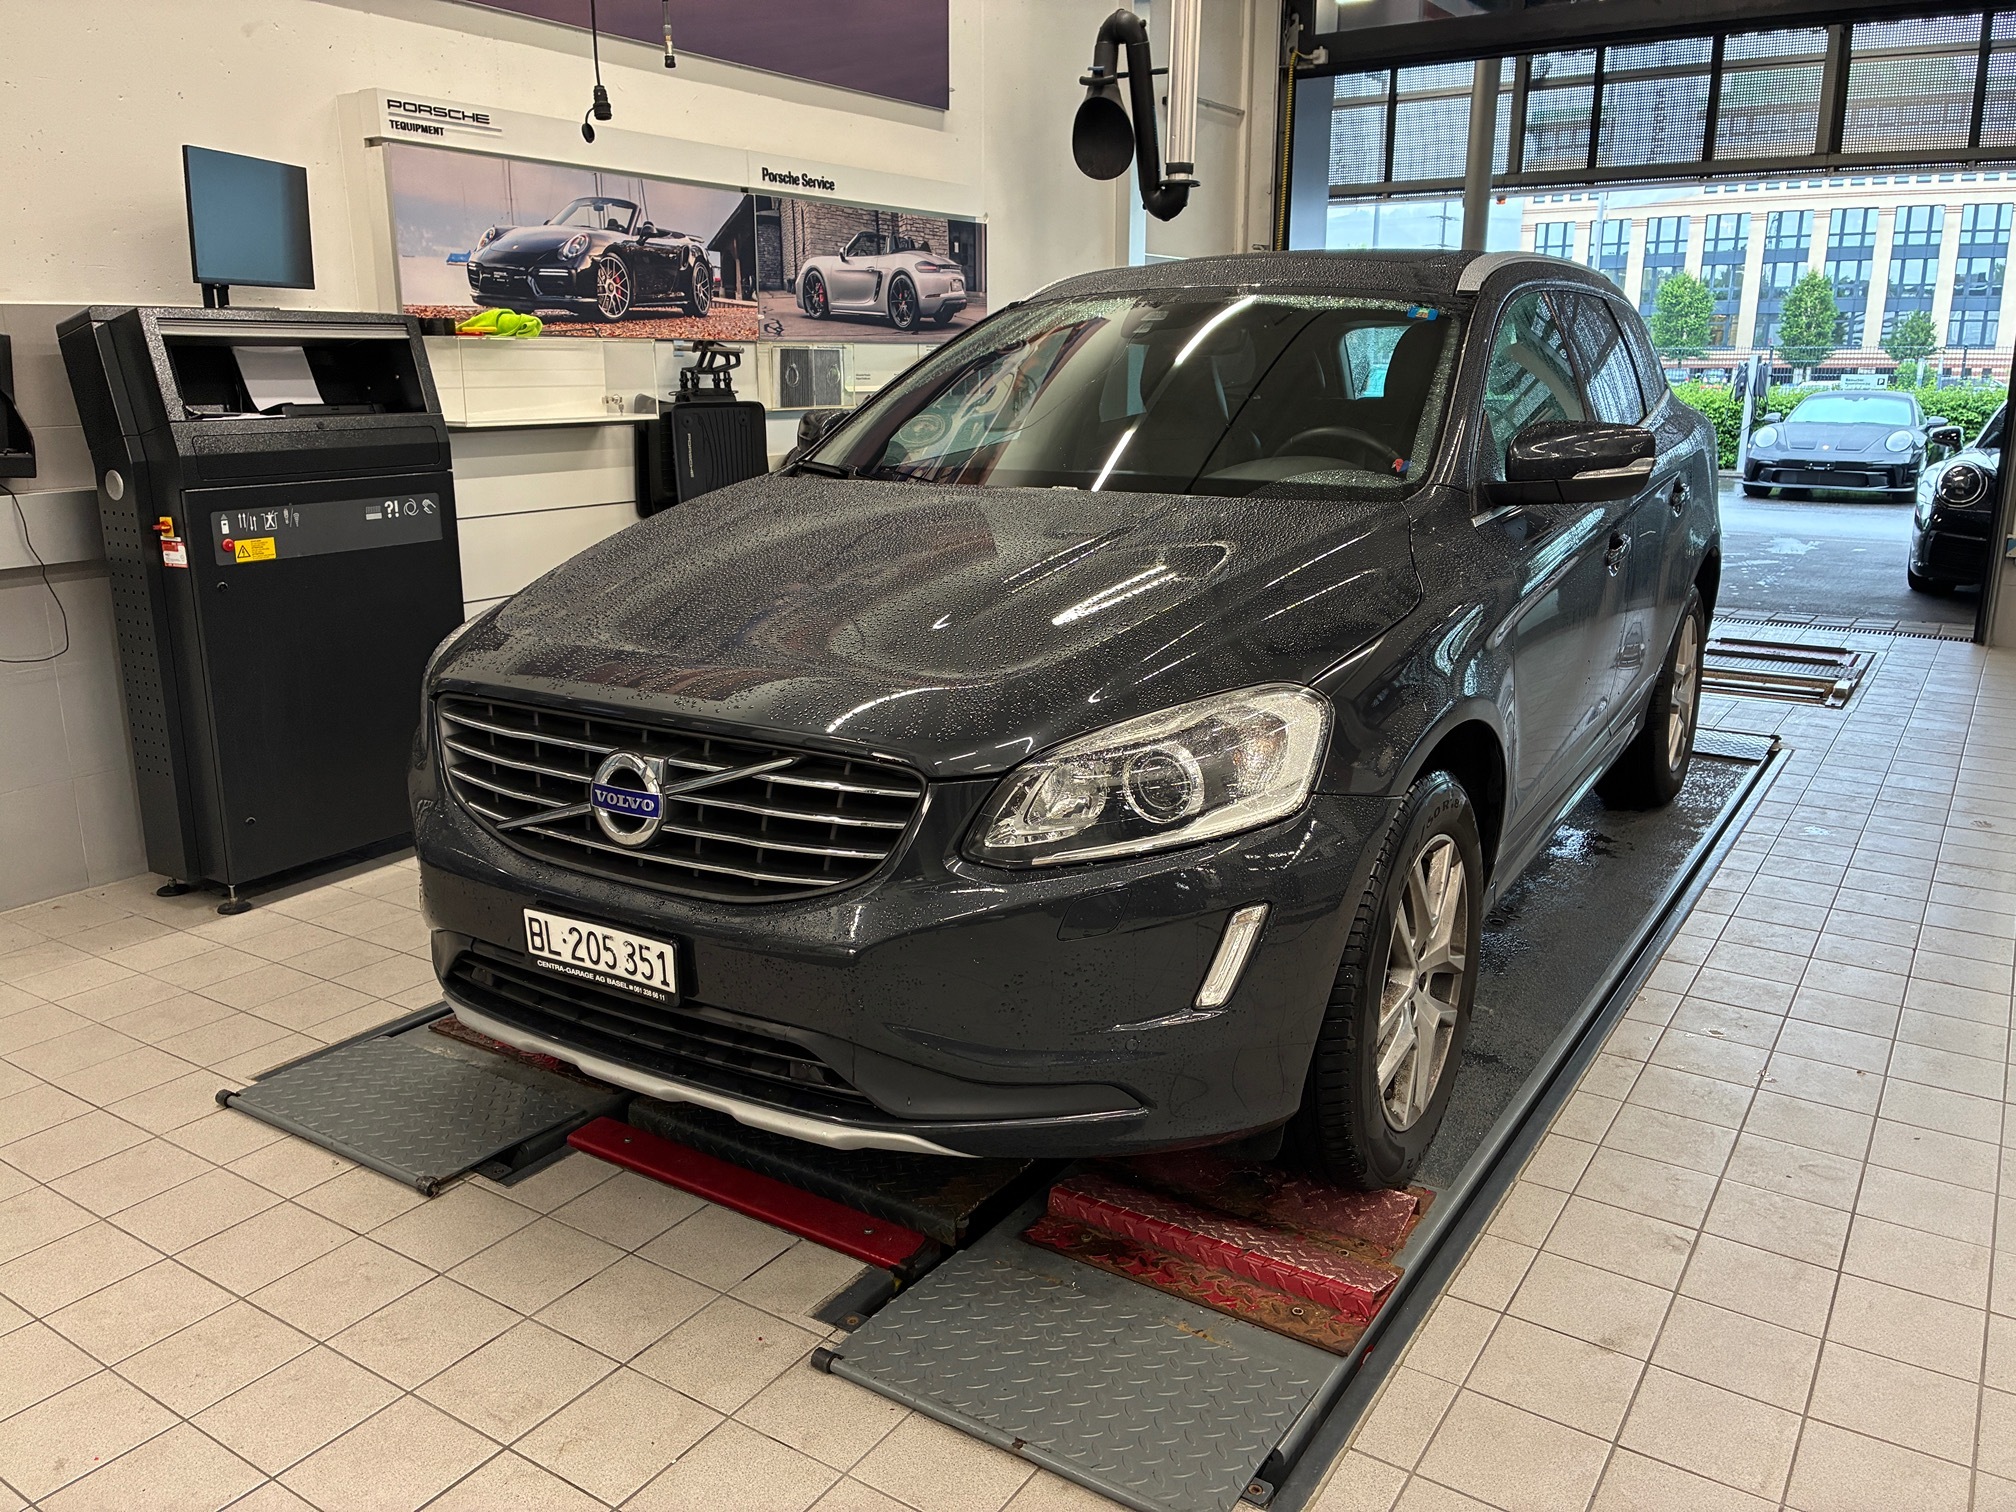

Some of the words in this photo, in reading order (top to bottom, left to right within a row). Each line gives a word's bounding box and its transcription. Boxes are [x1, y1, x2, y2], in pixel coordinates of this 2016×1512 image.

[386, 98, 490, 124] PORSCHE
[388, 119, 445, 136] TEQUIPMENT
[761, 166, 800, 186] Porsche
[801, 173, 835, 191] Service
[594, 789, 655, 812] VOLVO
[536, 959, 595, 980] CENTRA-GARAGE
[595, 975, 606, 983] AG
[606, 977, 629, 990] BASEL
